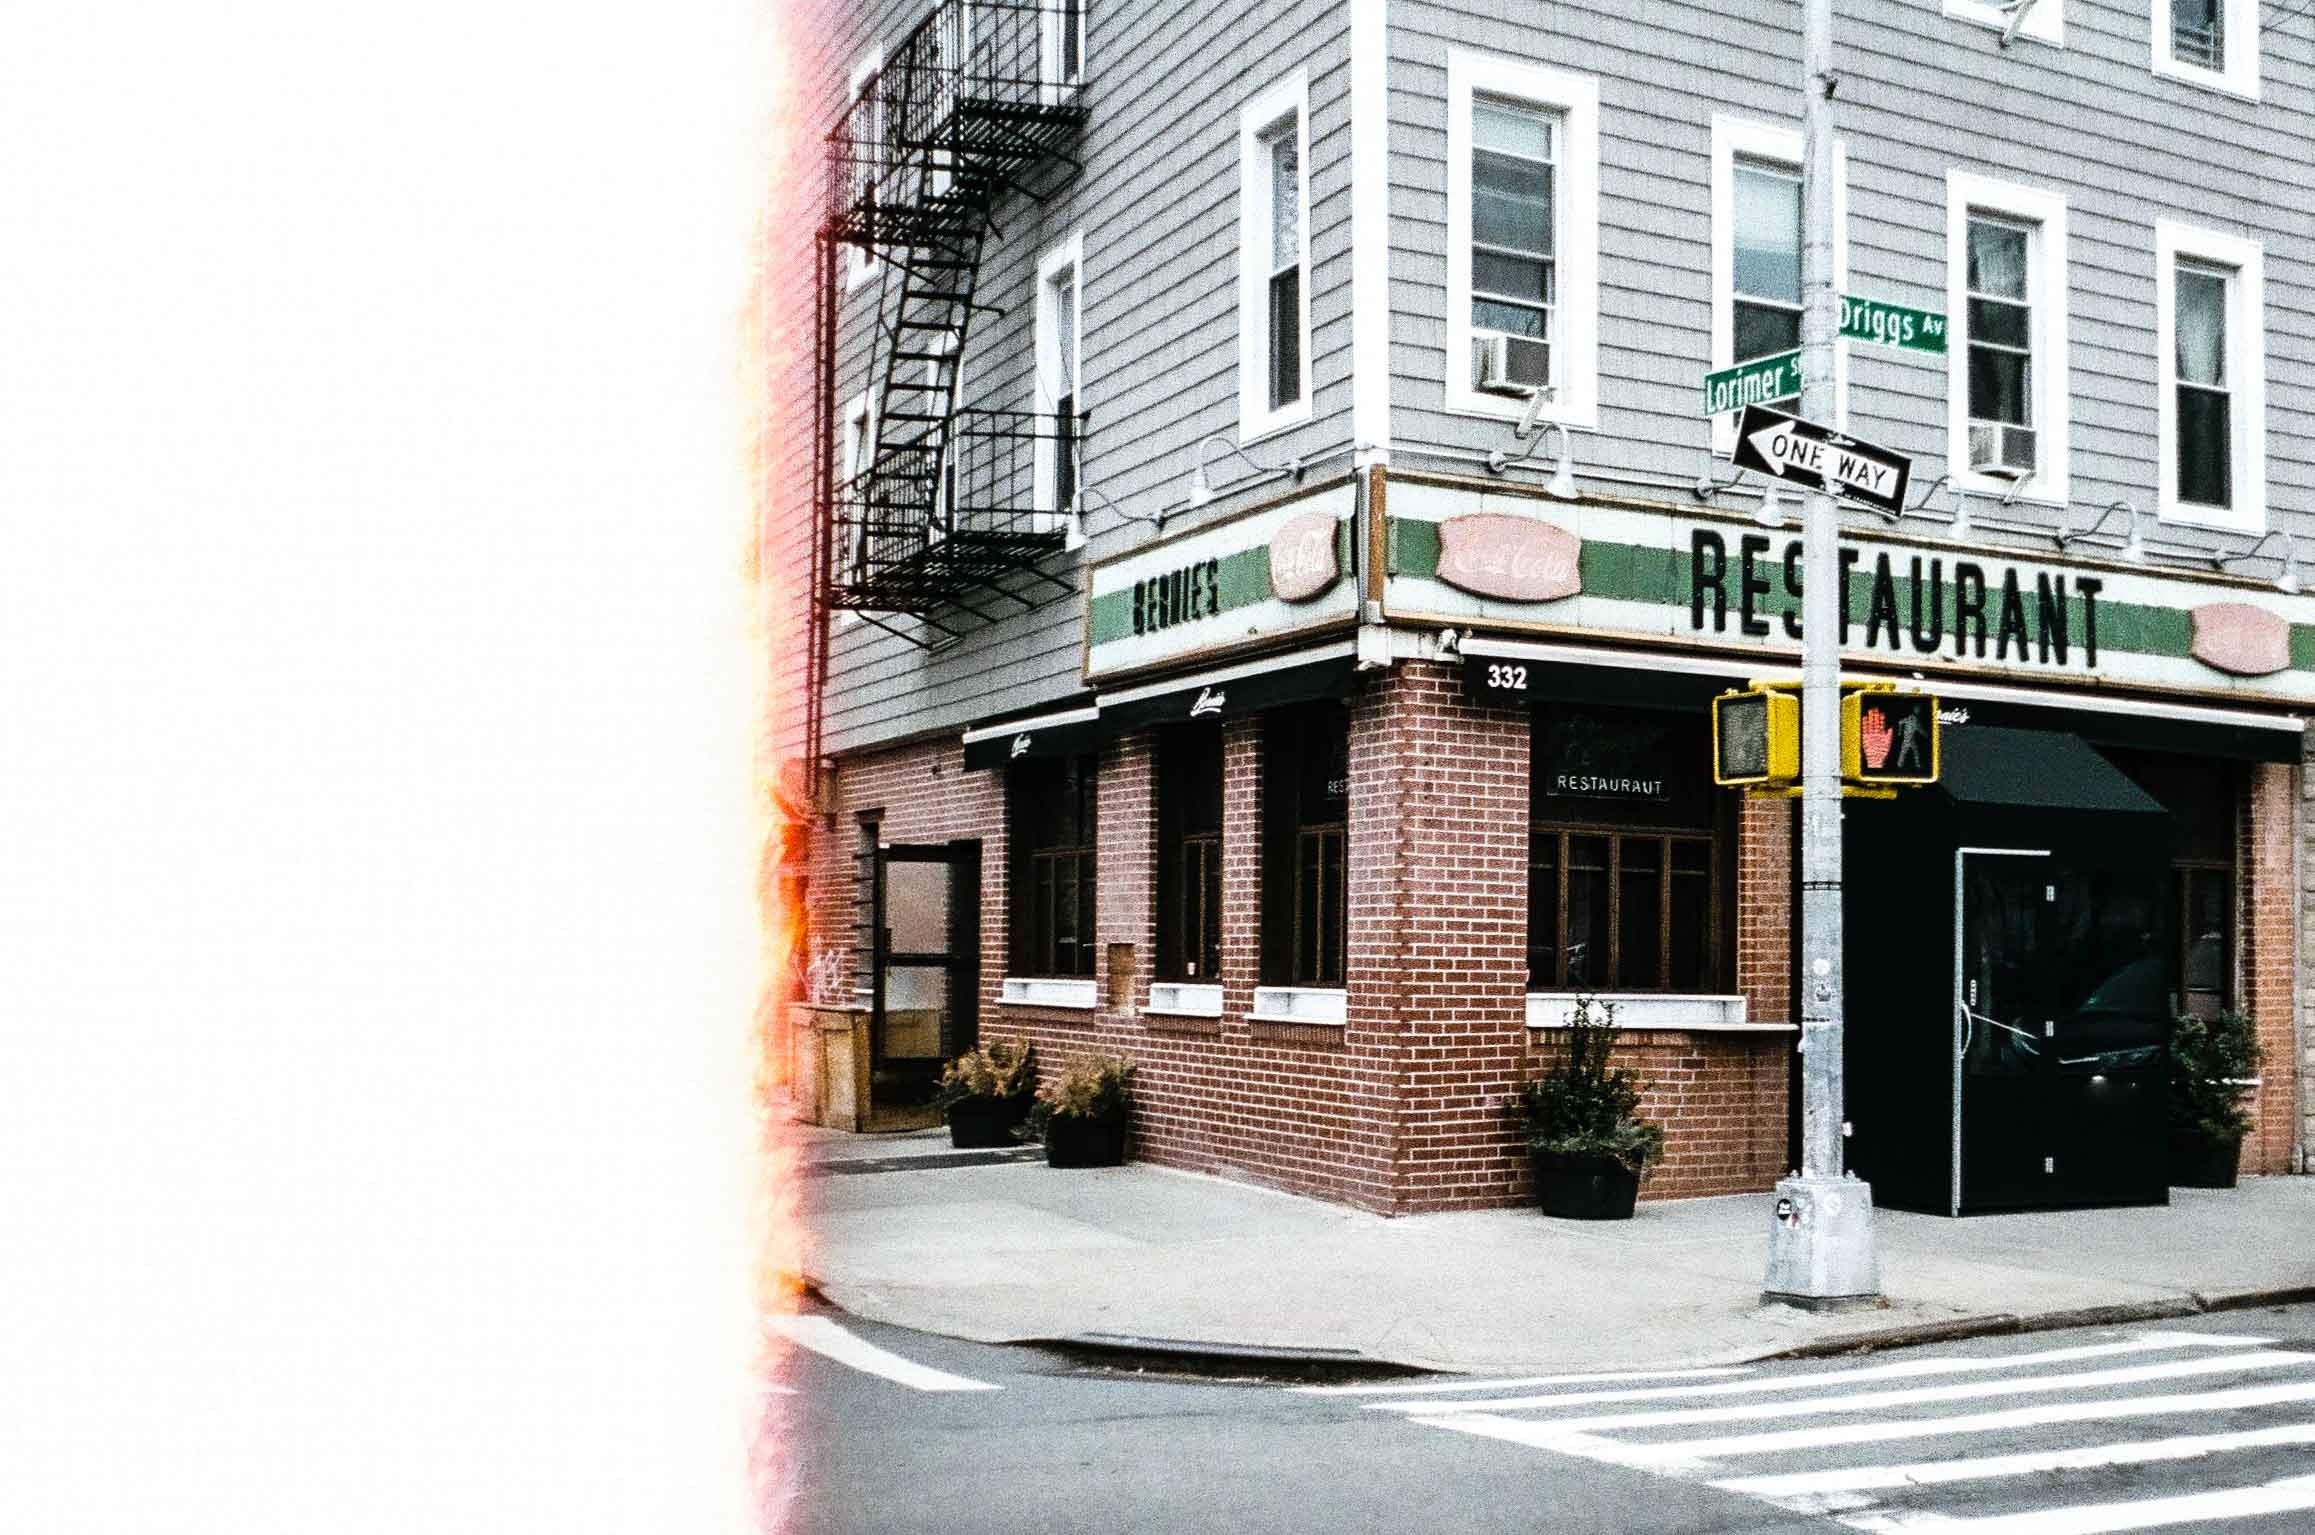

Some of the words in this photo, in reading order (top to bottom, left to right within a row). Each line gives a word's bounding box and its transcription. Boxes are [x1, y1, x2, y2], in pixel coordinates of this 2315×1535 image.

[1840, 299, 1913, 347] Driggs
[1707, 367, 1784, 411] Lorimer
[1772, 434, 1825, 469] ONE
[1838, 454, 1887, 489] WAY
[1691, 528, 2103, 669] RESTAURANT
[1488, 664, 1527, 689] 332
